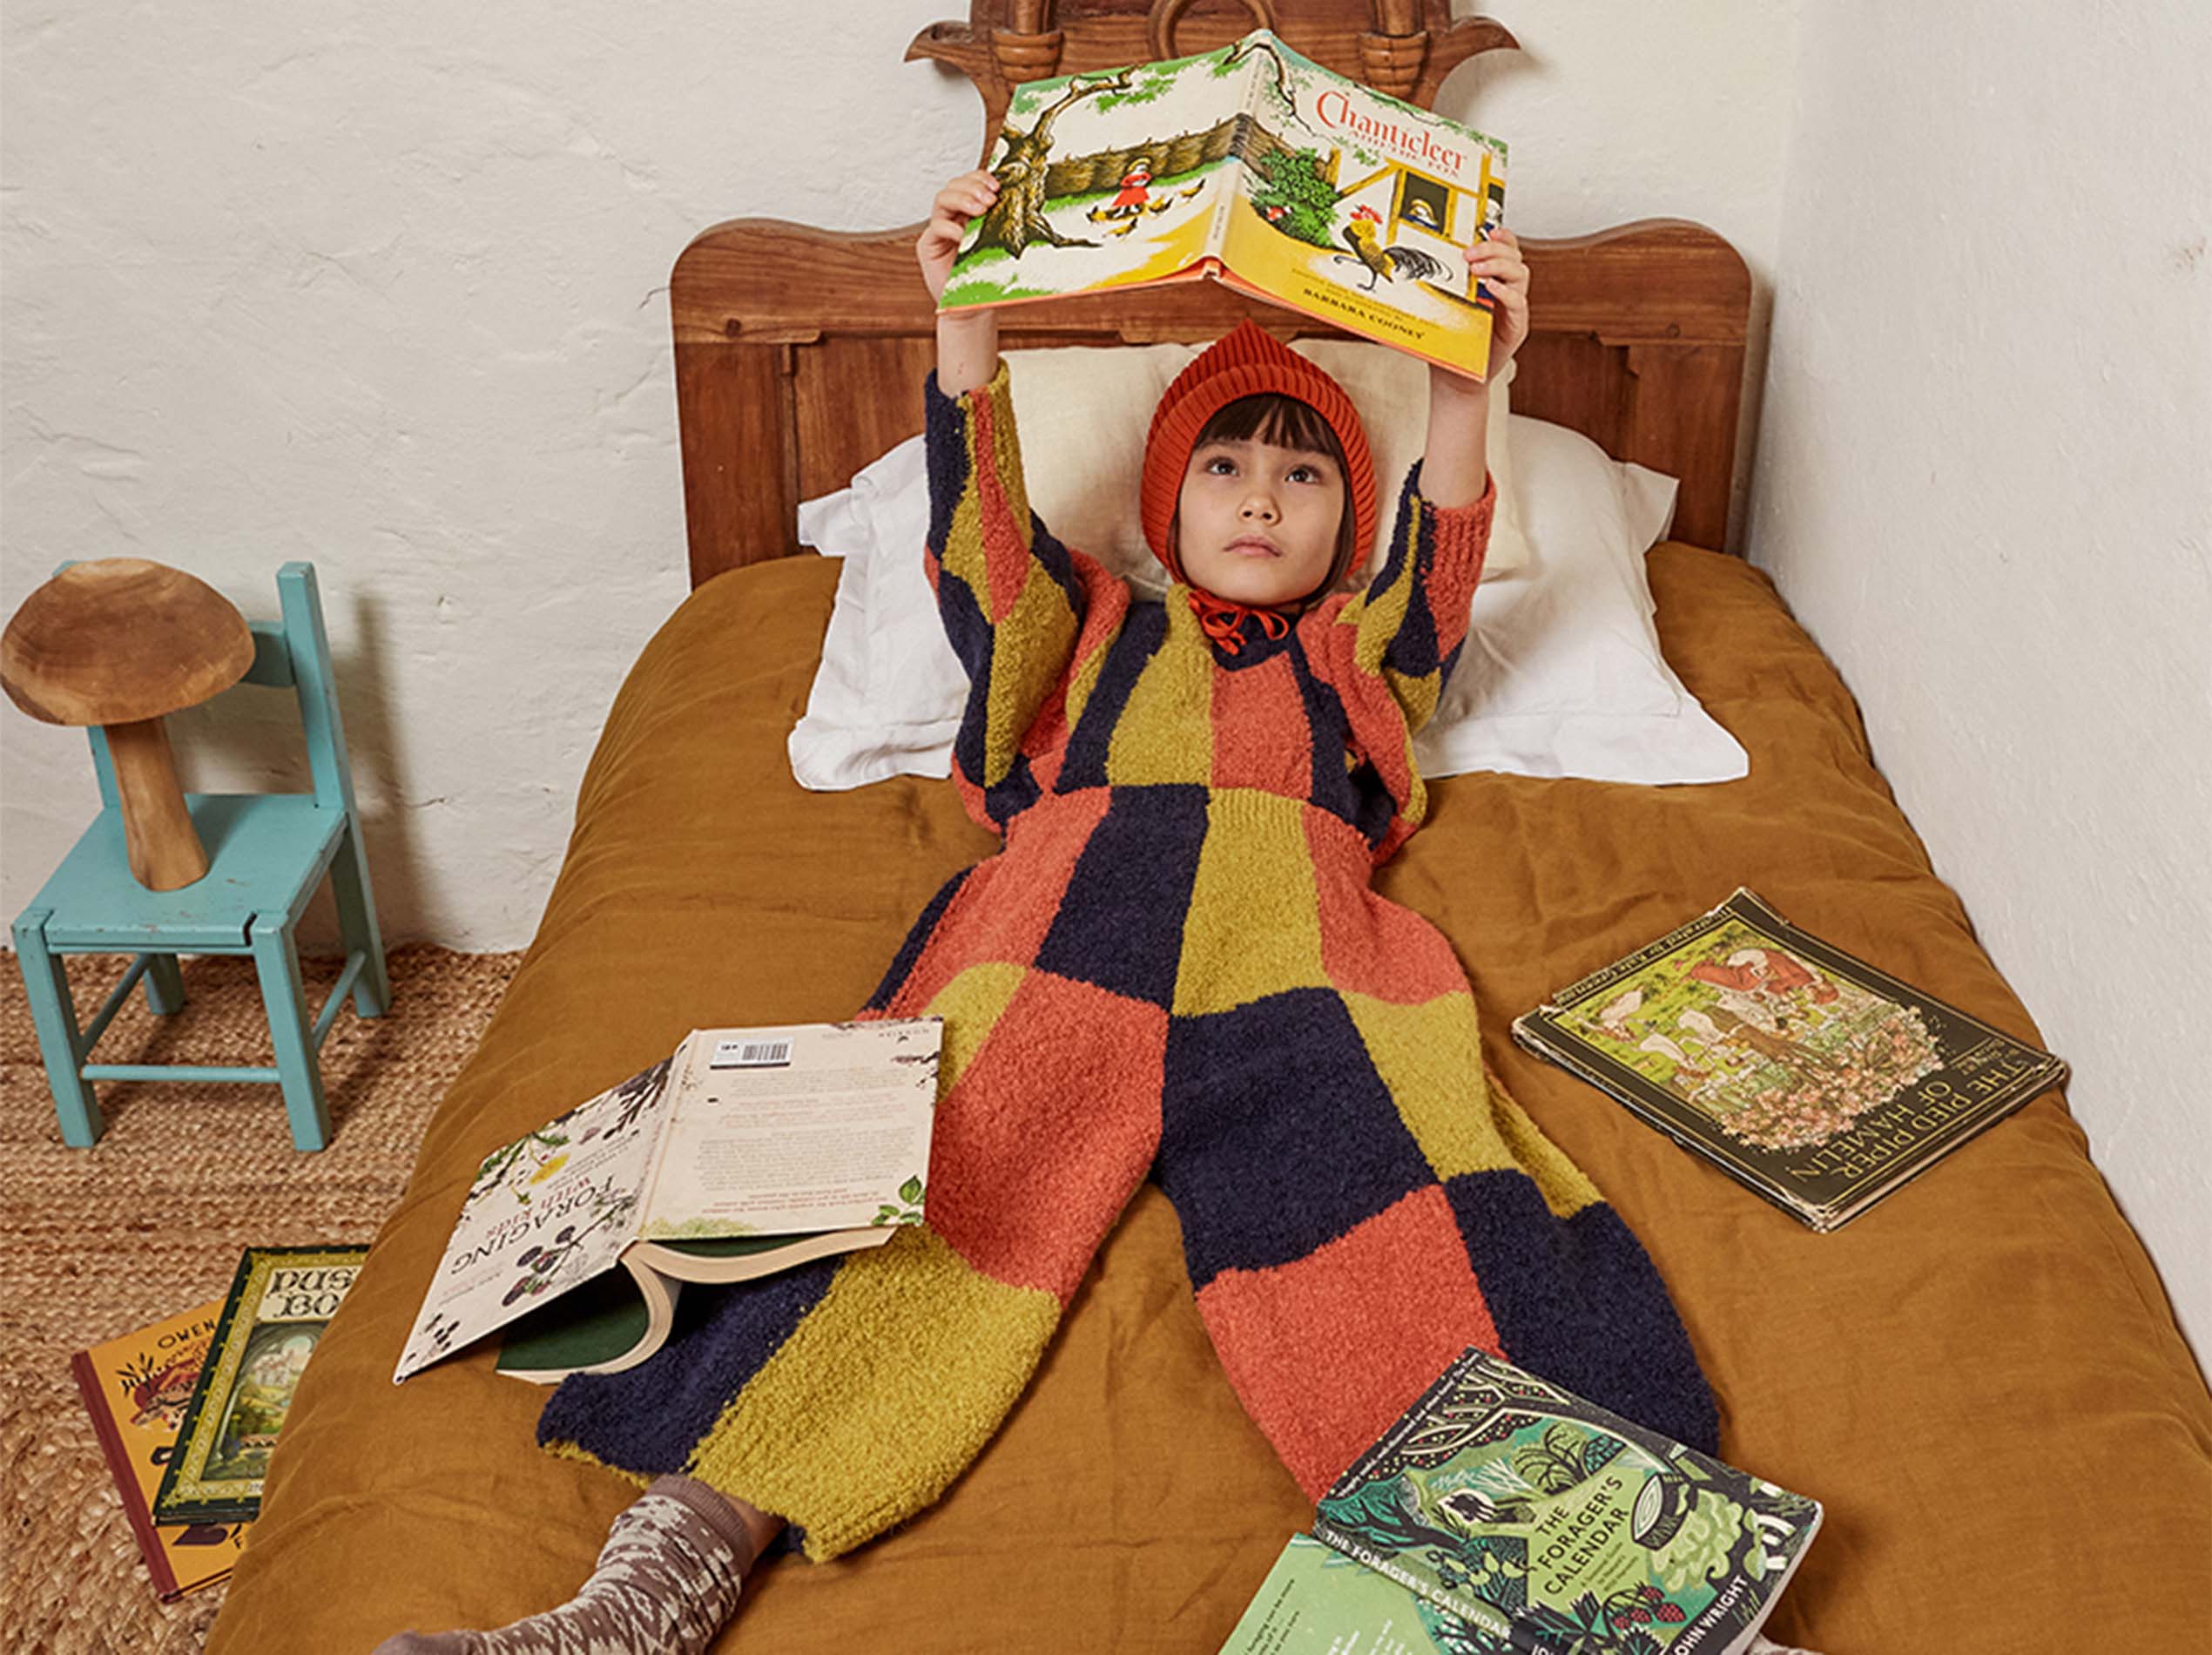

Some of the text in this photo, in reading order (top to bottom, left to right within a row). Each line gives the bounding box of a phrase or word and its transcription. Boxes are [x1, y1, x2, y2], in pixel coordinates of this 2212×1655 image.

[1316, 90, 1461, 170] Chanticleer
[1304, 288, 1366, 319] BARBARA
[1368, 313, 1426, 339] COONEY
[1790, 1080, 1951, 1183] OF HAMELIN
[1829, 1057, 2029, 1179] THE PIED PIPER
[451, 1176, 613, 1274] FORAGING
[158, 1318, 217, 1349] OWEN
[277, 1293, 340, 1316] BO
[1534, 1505, 1570, 1537] THE
[1537, 1476, 1623, 1570] FORAGER'S
[1543, 1507, 1630, 1596] CALENDAR
[1325, 1530, 1349, 1551] THE
[1351, 1544, 1429, 1596] FORAGER'S
[1431, 1589, 1512, 1640] CALENDAR
[1674, 1574, 1748, 1655] OHN WRIGHT
